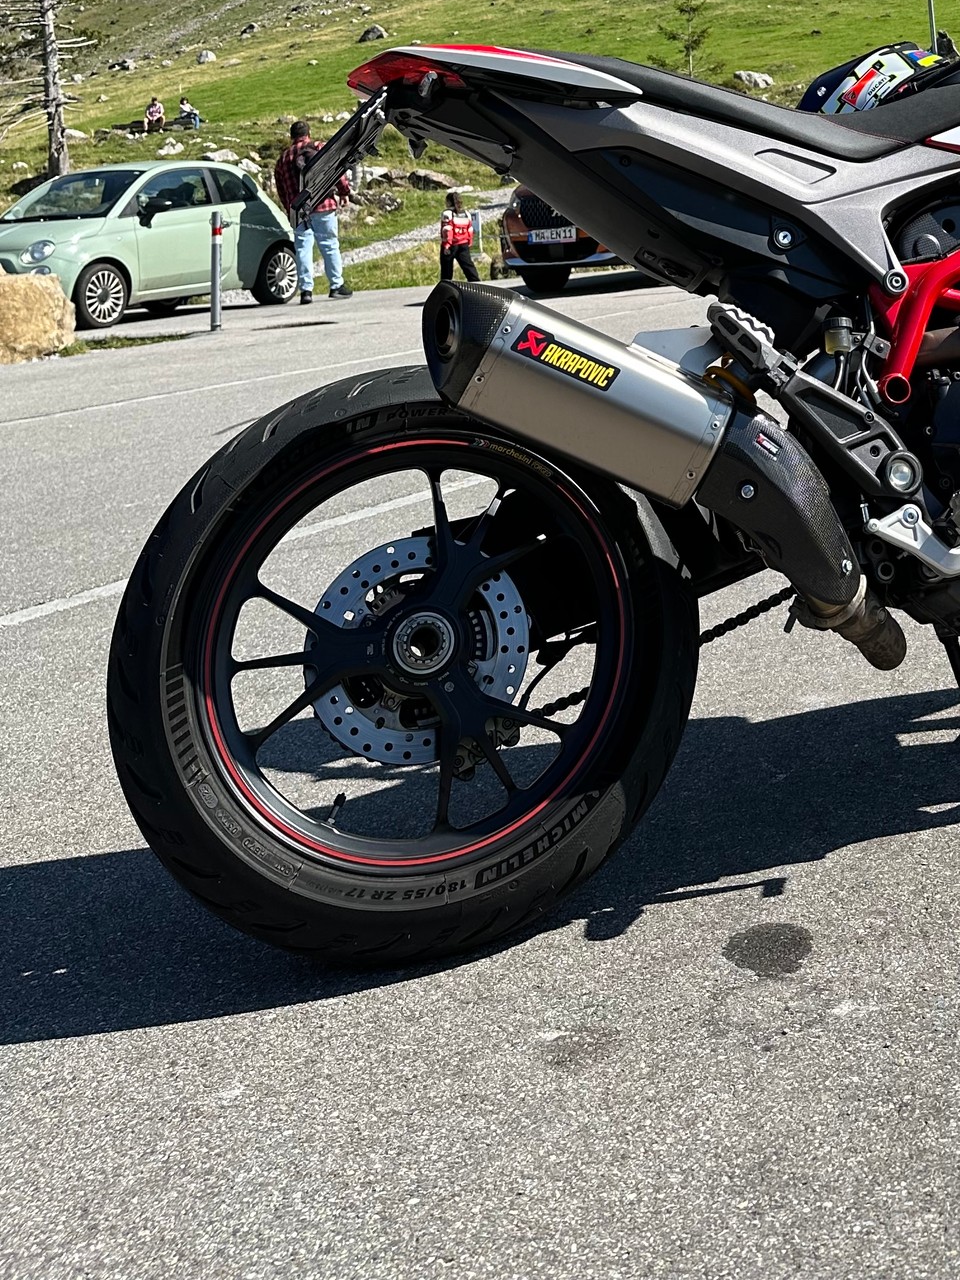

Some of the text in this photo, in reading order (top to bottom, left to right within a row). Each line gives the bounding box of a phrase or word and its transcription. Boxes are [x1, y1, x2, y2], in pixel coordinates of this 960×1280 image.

[867, 76, 888, 96] DUCATI
[482, 800, 590, 885] MICHELIN
[345, 881, 466, 901] 180/55 ZR 17
